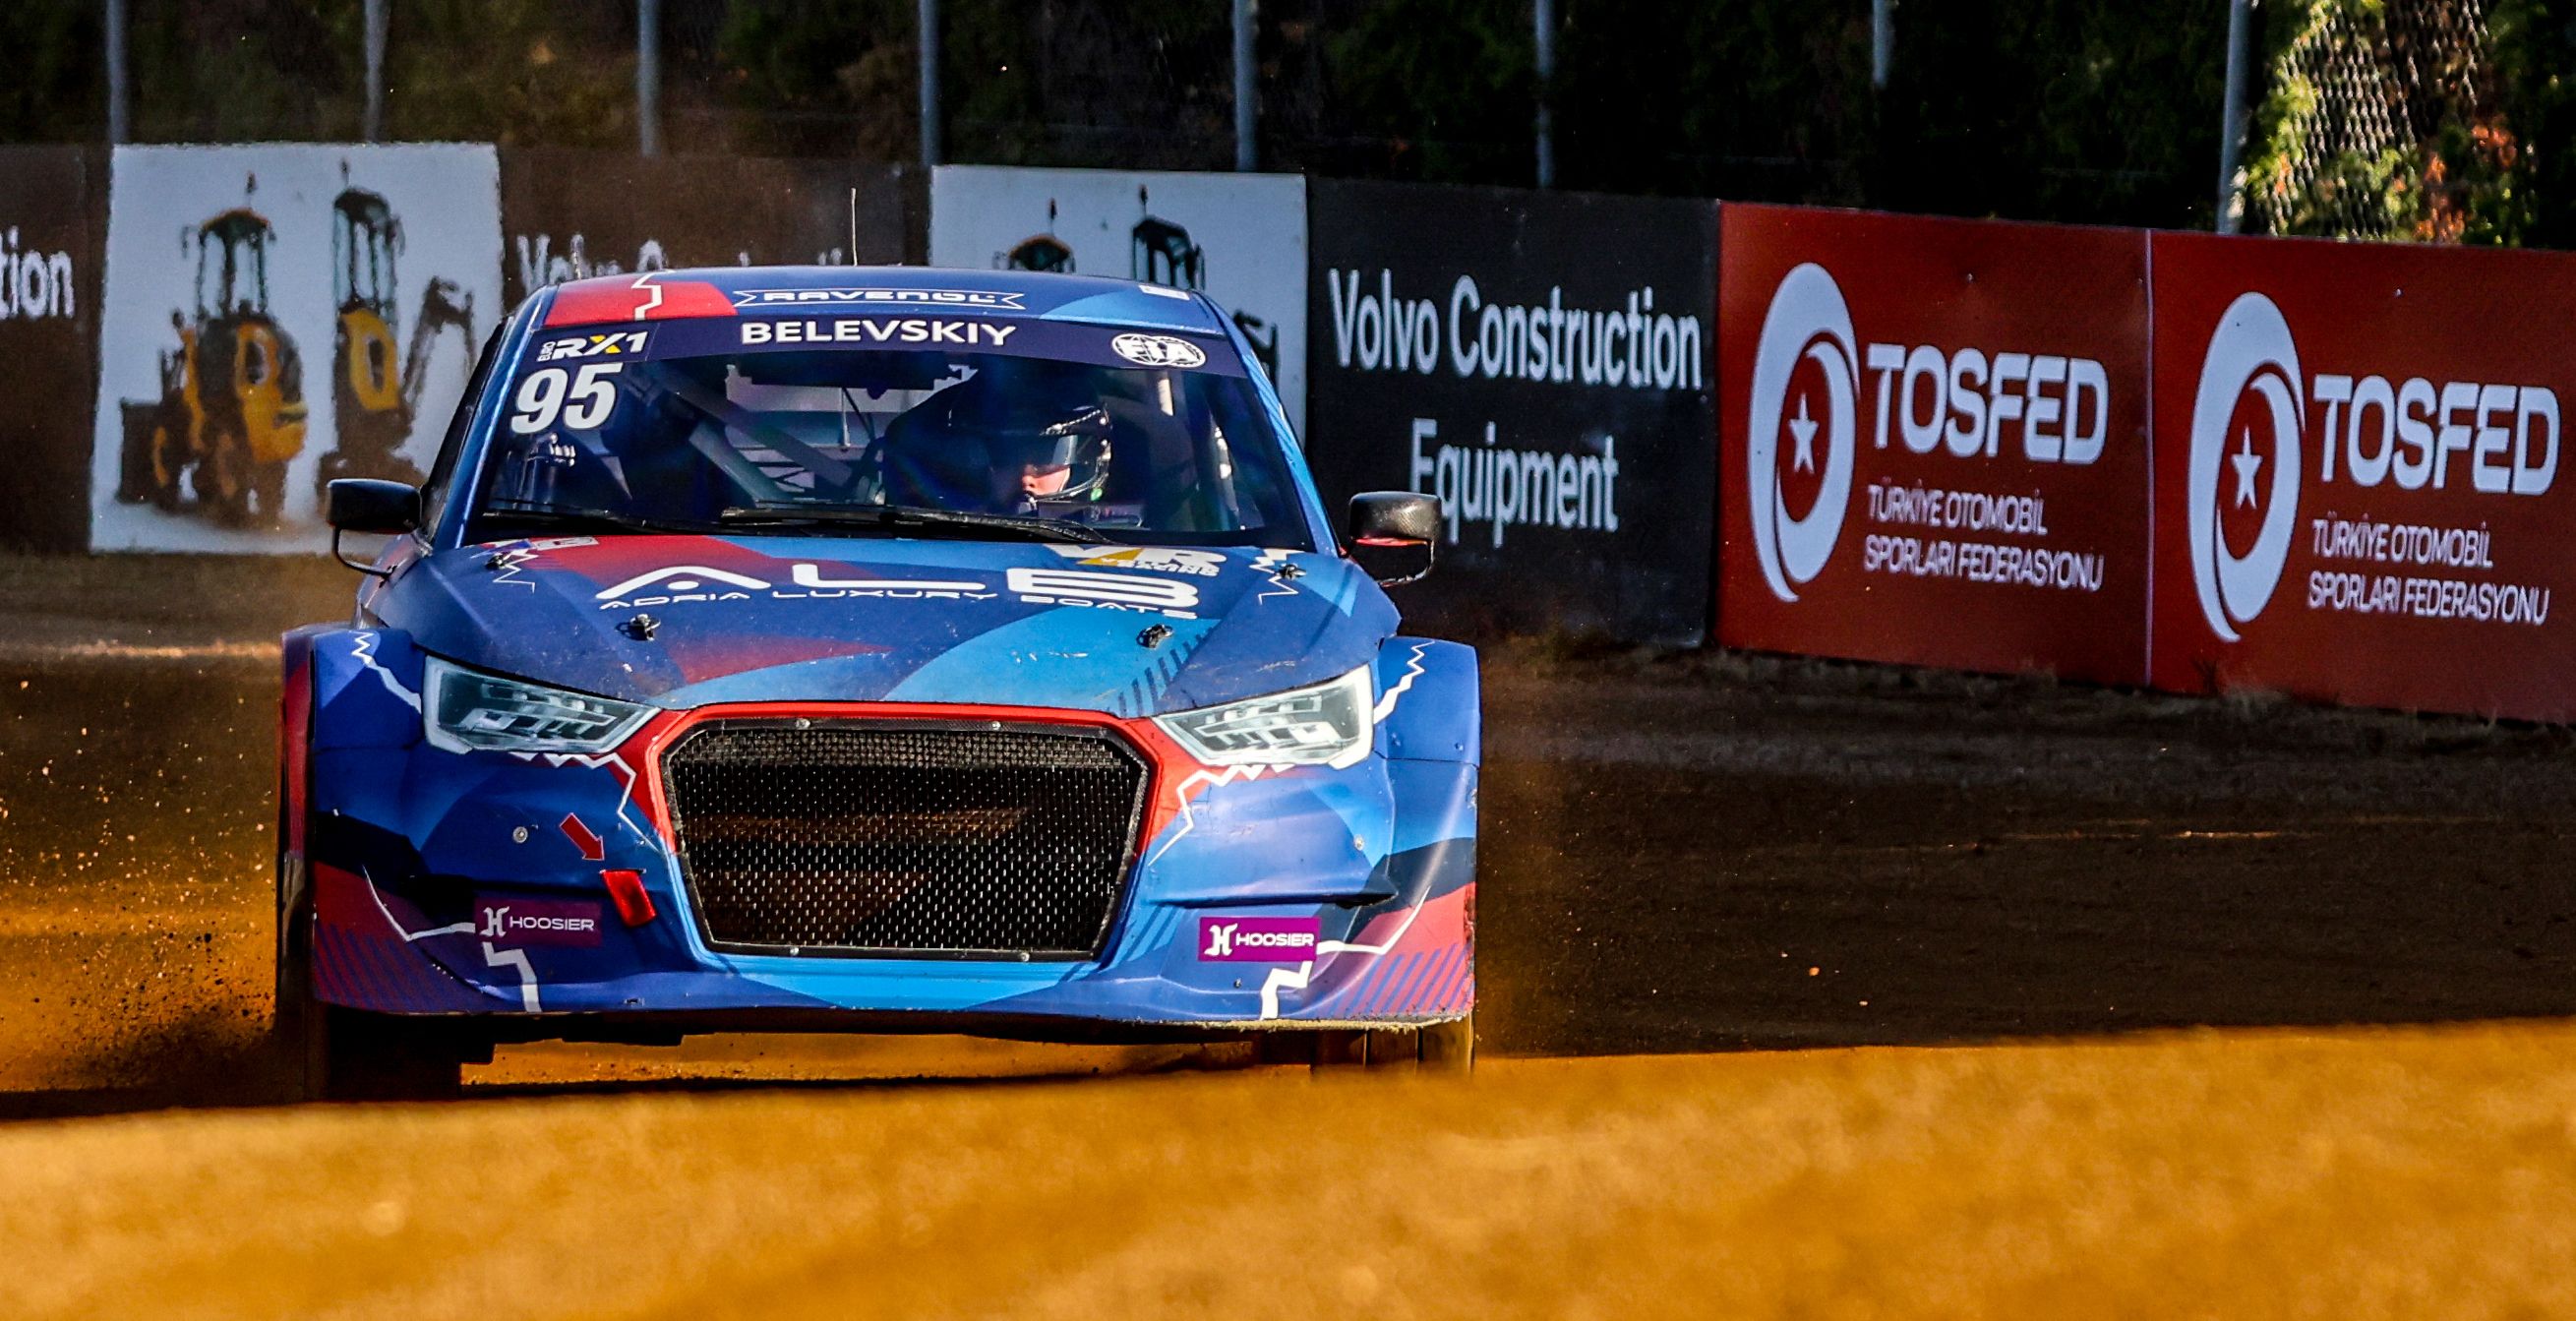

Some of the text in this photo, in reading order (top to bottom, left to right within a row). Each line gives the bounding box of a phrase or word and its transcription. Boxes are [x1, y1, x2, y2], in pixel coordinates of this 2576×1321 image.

[763, 290, 995, 304] RAVENOL
[552, 331, 648, 359] RX1
[742, 320, 1016, 345] BELEVSKIY
[1111, 334, 1203, 367] FIA
[1329, 269, 1702, 391] Volvo Construction
[510, 362, 624, 434] 95
[1867, 343, 2109, 464] TOSFED
[2313, 374, 2561, 495] TOSFED
[1410, 418, 1618, 548] Equipment
[1868, 476, 2048, 536] TÜRKİYE OTOMOBİL
[1864, 535, 2104, 592] SPORLARI FEDERASYONU
[2311, 510, 2493, 569] TÜRKİYE OTOMOBİL
[600, 590, 1198, 620] ADRIA LUXURY BOATS
[2309, 570, 2550, 626] SPORLARI FEDERASYONU
[509, 917, 595, 931] HOOSIER
[1235, 932, 1315, 946] HOOSIER
